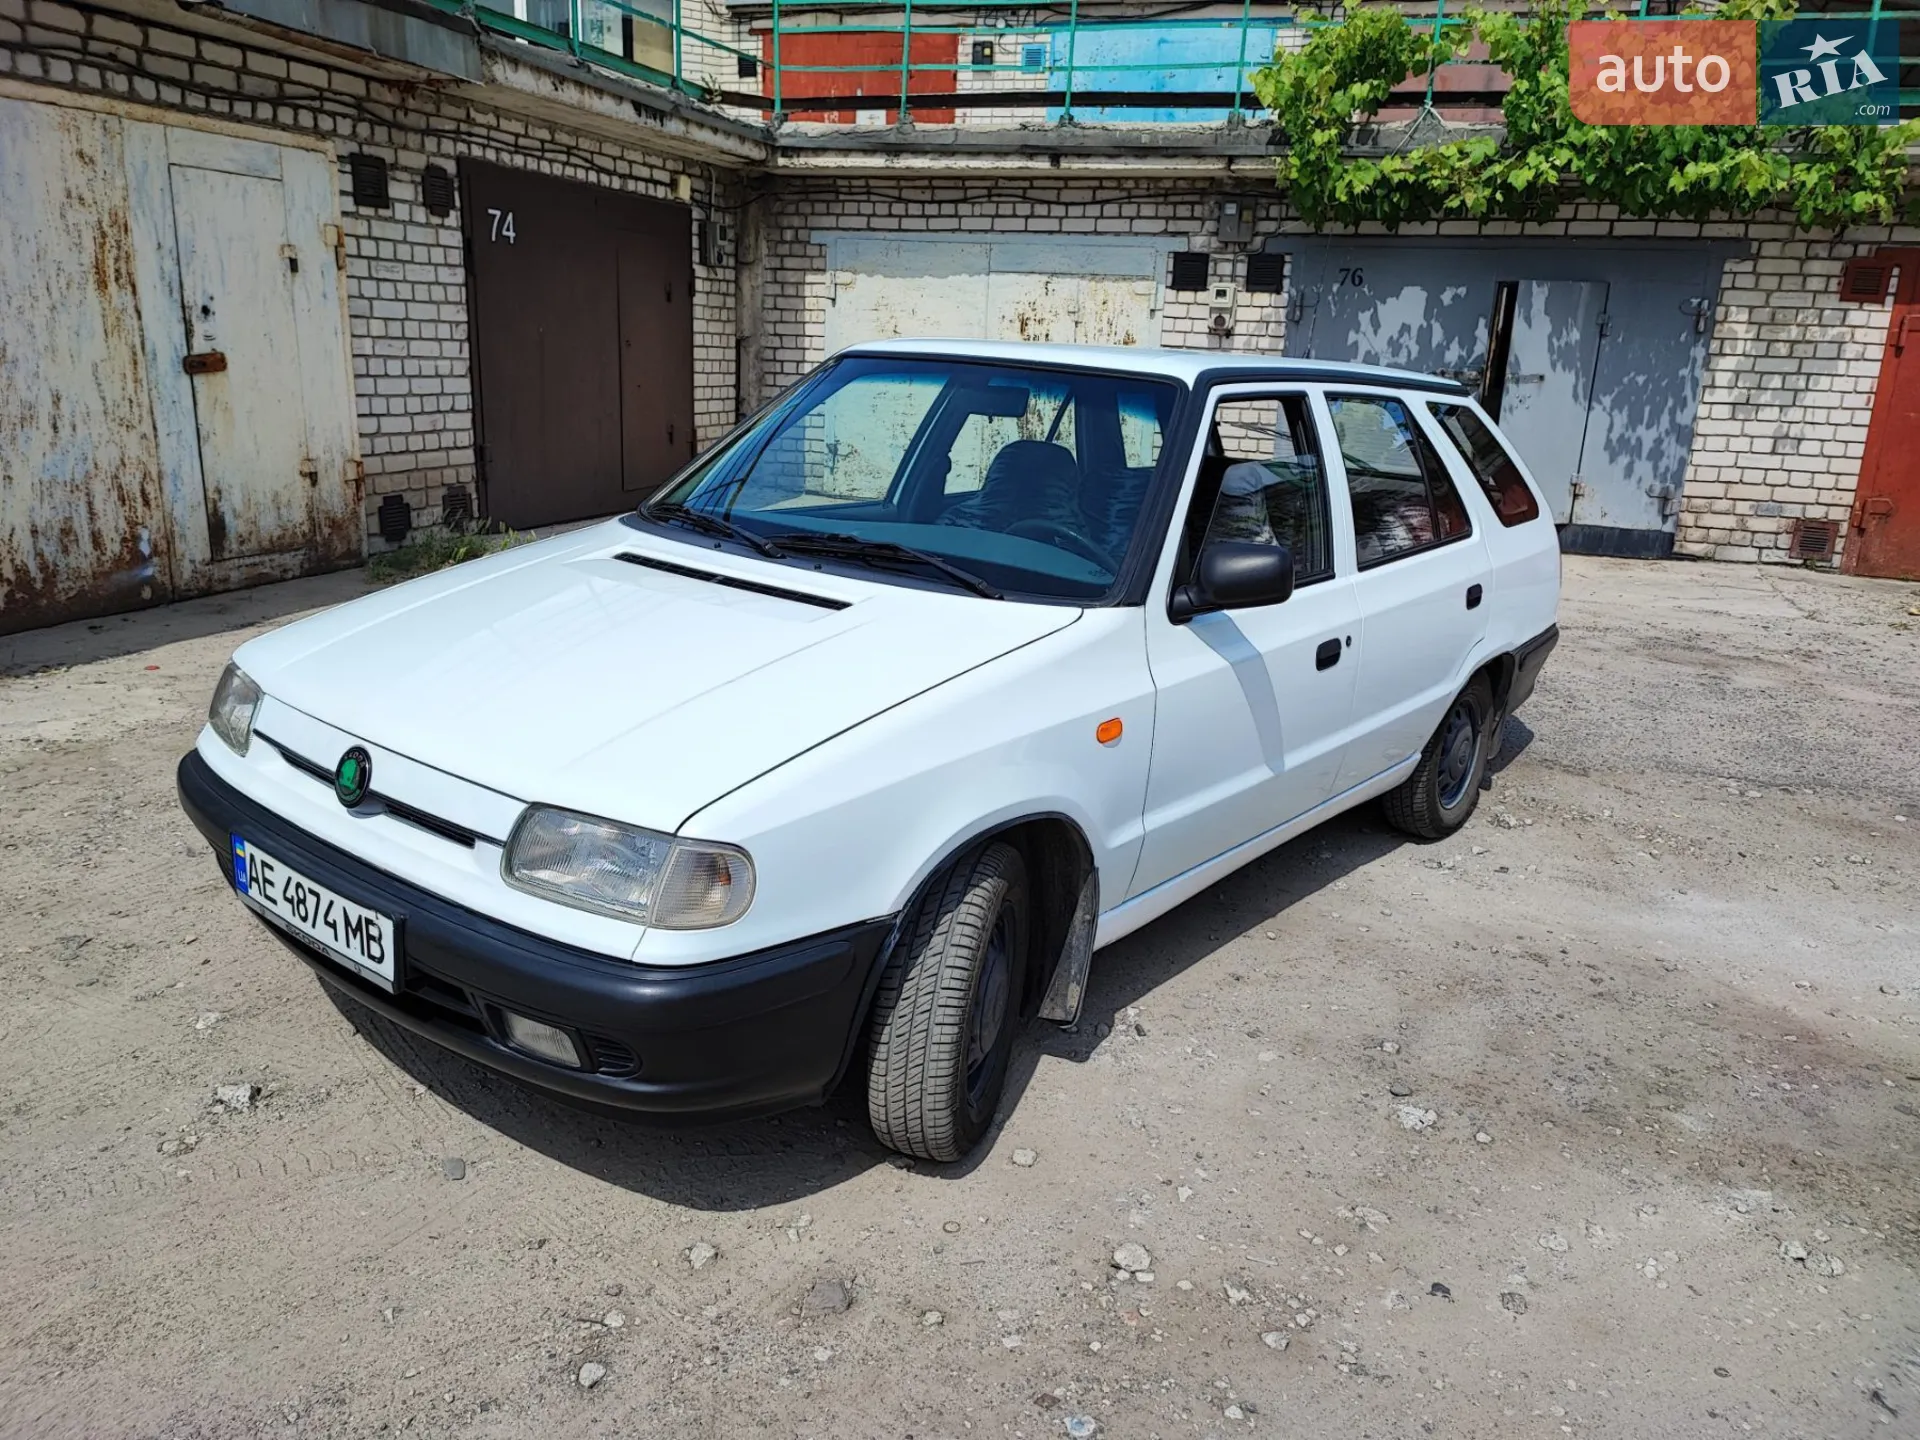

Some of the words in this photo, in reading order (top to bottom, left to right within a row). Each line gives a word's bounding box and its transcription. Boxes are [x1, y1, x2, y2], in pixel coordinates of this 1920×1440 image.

[487, 208, 516, 244] 74
[1339, 267, 1364, 287] 76
[249, 852, 278, 906] AE
[282, 876, 338, 942] 4874
[343, 906, 385, 964] MB
